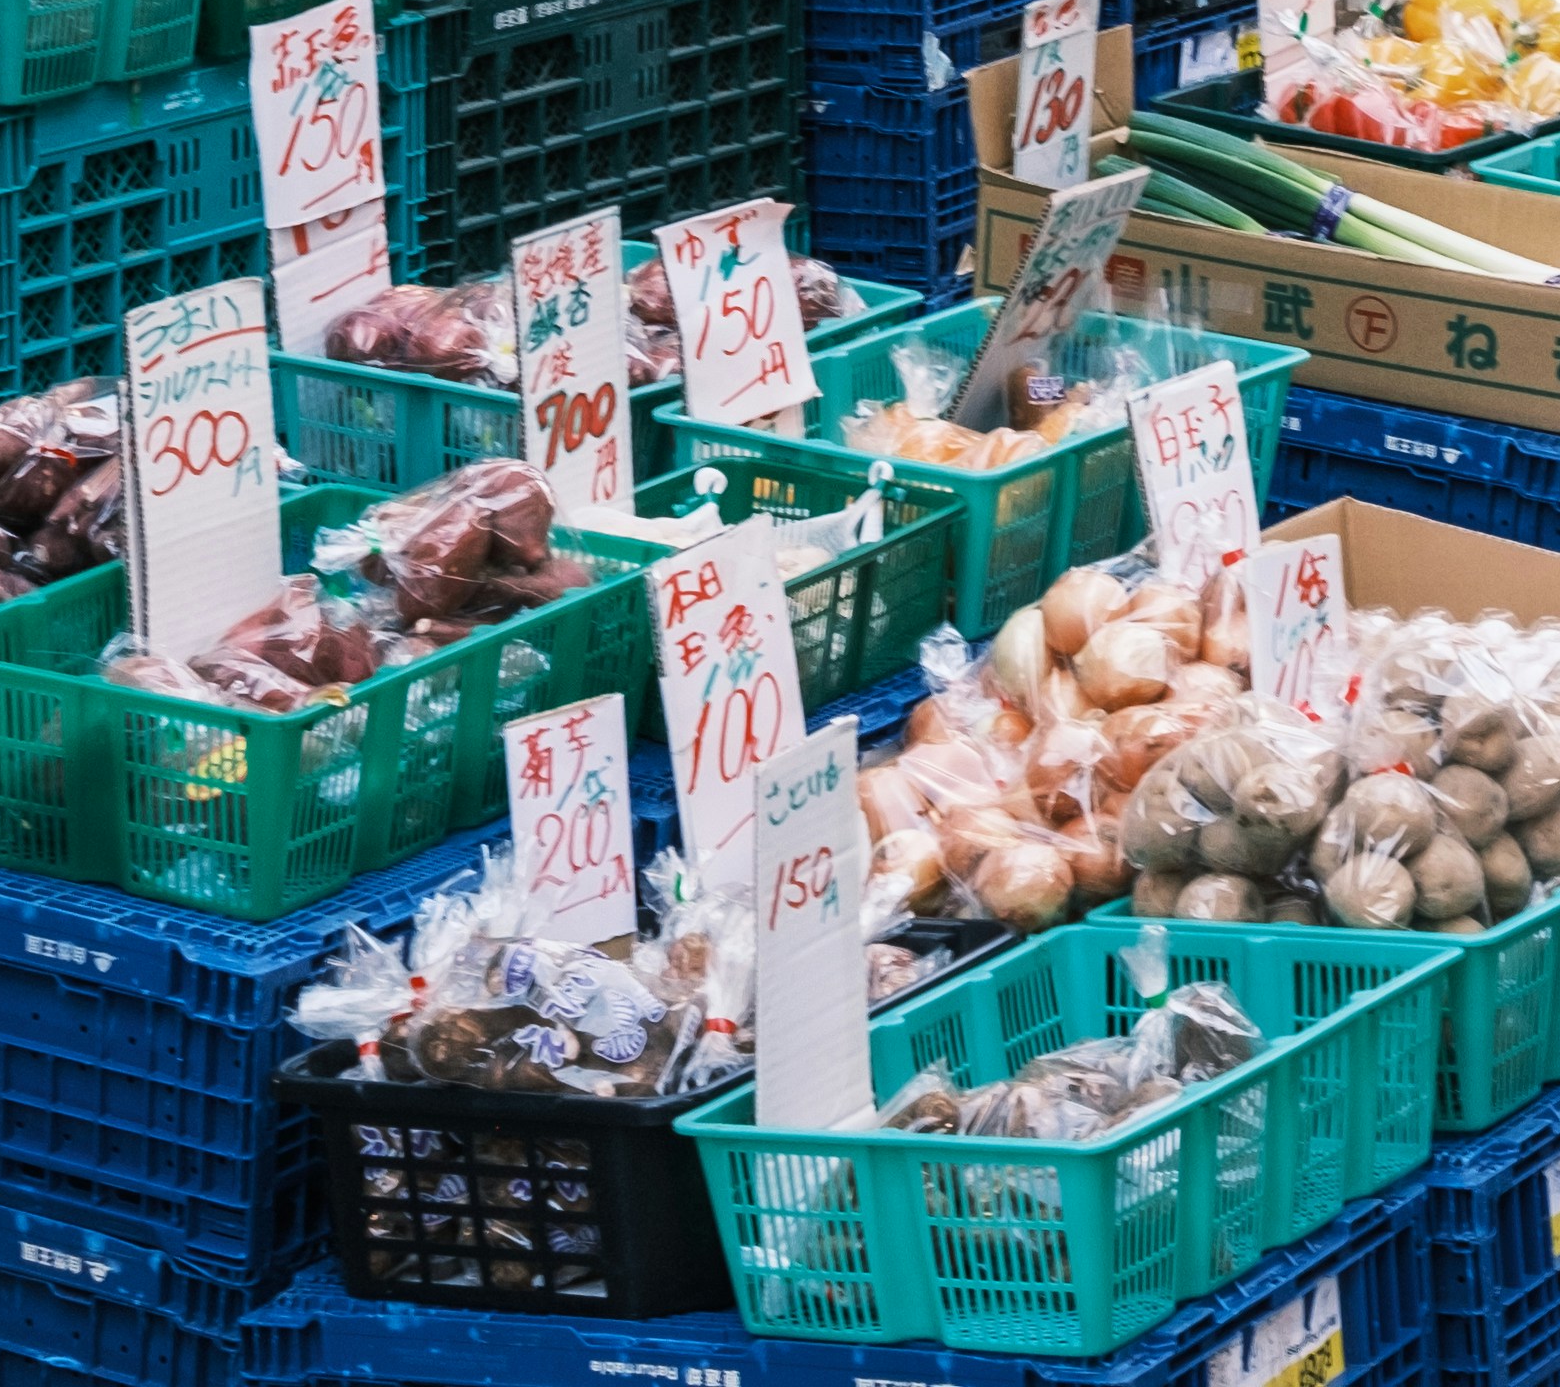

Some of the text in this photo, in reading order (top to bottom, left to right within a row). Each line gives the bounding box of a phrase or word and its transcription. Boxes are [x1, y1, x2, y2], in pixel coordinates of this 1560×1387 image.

[136, 295, 242, 360] うまい
[518, 708, 595, 800] 菊芋
[687, 670, 783, 795] 100
